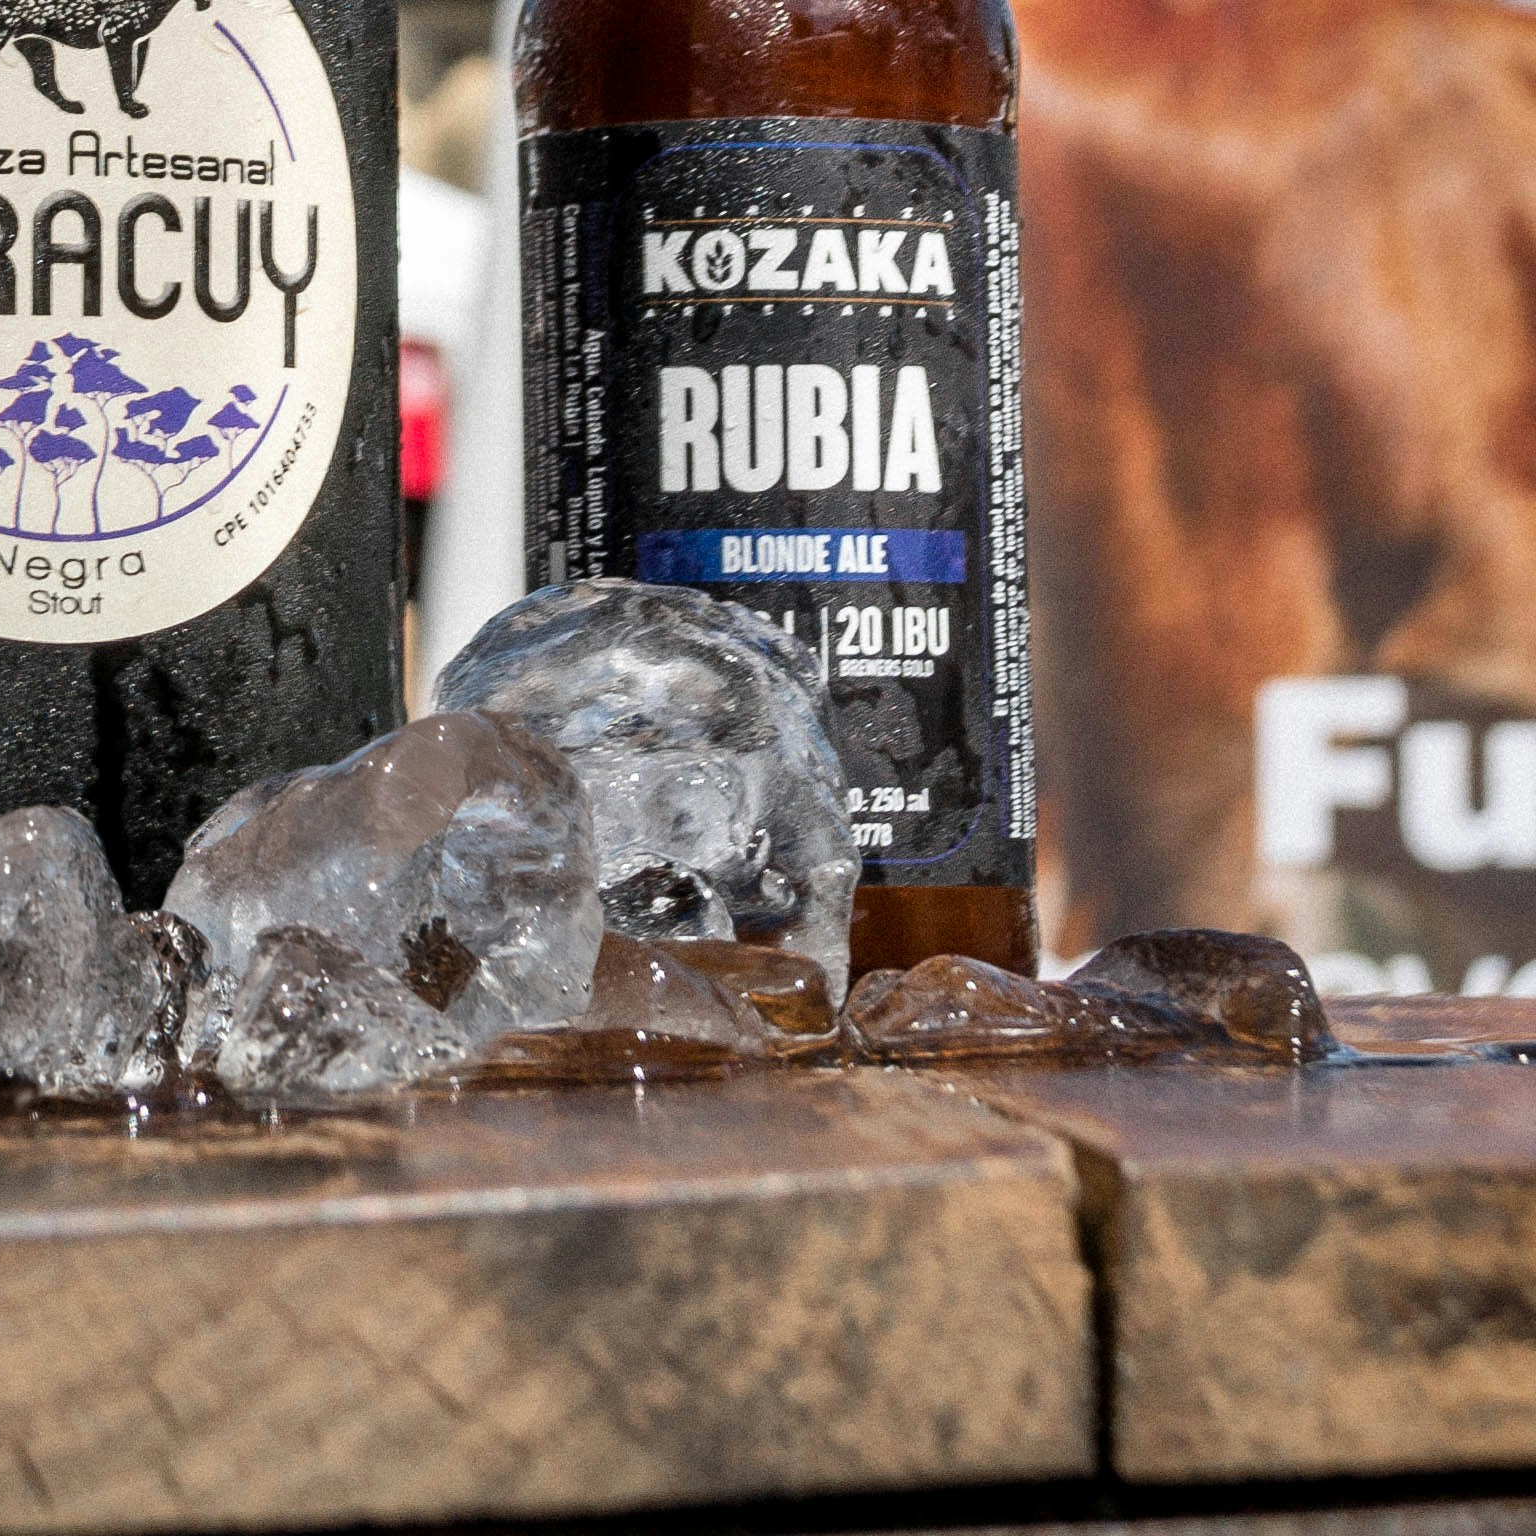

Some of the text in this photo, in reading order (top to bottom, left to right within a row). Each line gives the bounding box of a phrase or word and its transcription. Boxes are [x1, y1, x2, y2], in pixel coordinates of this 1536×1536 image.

[69, 129, 275, 185] Artesanal
[642, 228, 957, 296] KOZAKA
[660, 364, 943, 493] RUBIA
[214, 512, 249, 546] CPE
[721, 534, 889, 574] BLONDE ALE
[29, 589, 103, 615] Stout
[835, 606, 884, 656] 20
[892, 606, 951, 657] IBU
[870, 787, 904, 813] 250
